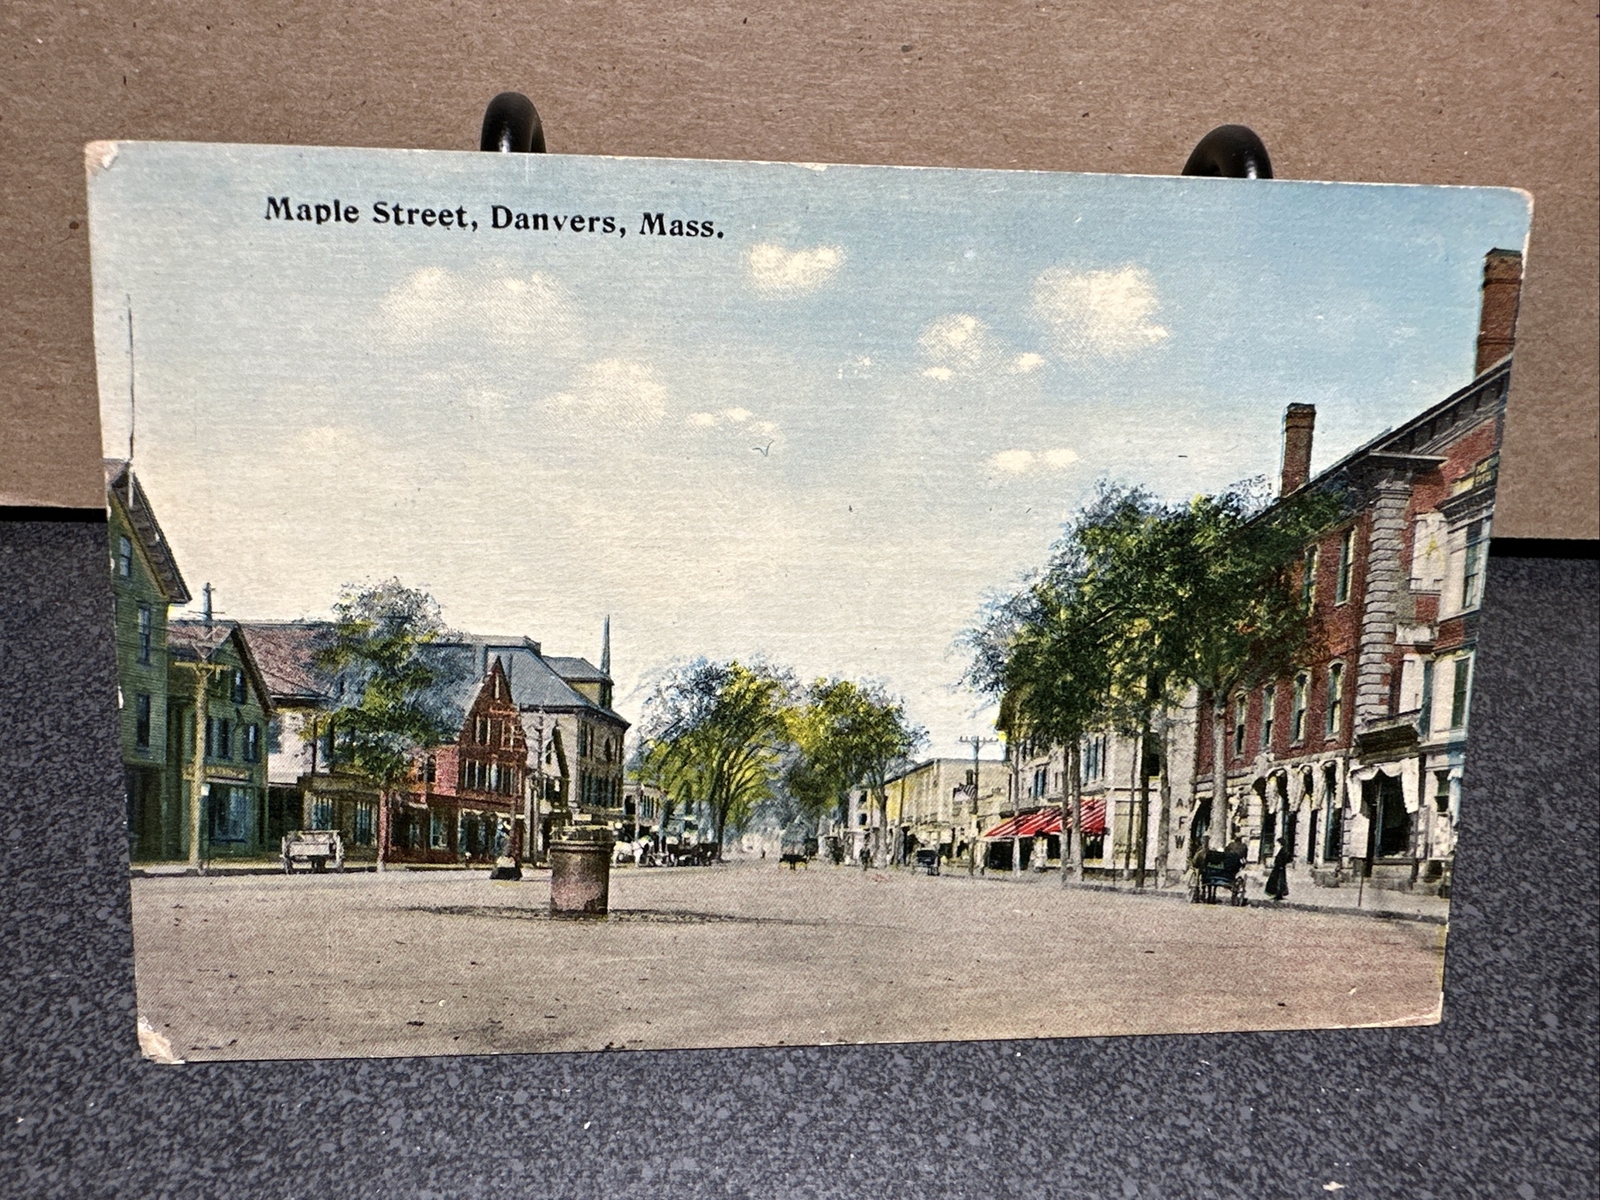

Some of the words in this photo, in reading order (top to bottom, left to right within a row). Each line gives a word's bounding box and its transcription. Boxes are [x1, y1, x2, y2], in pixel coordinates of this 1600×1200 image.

[264, 196, 361, 225] Maple
[372, 201, 479, 232] Street,
[491, 205, 627, 239] Danvers,
[639, 212, 725, 239] Mass.
